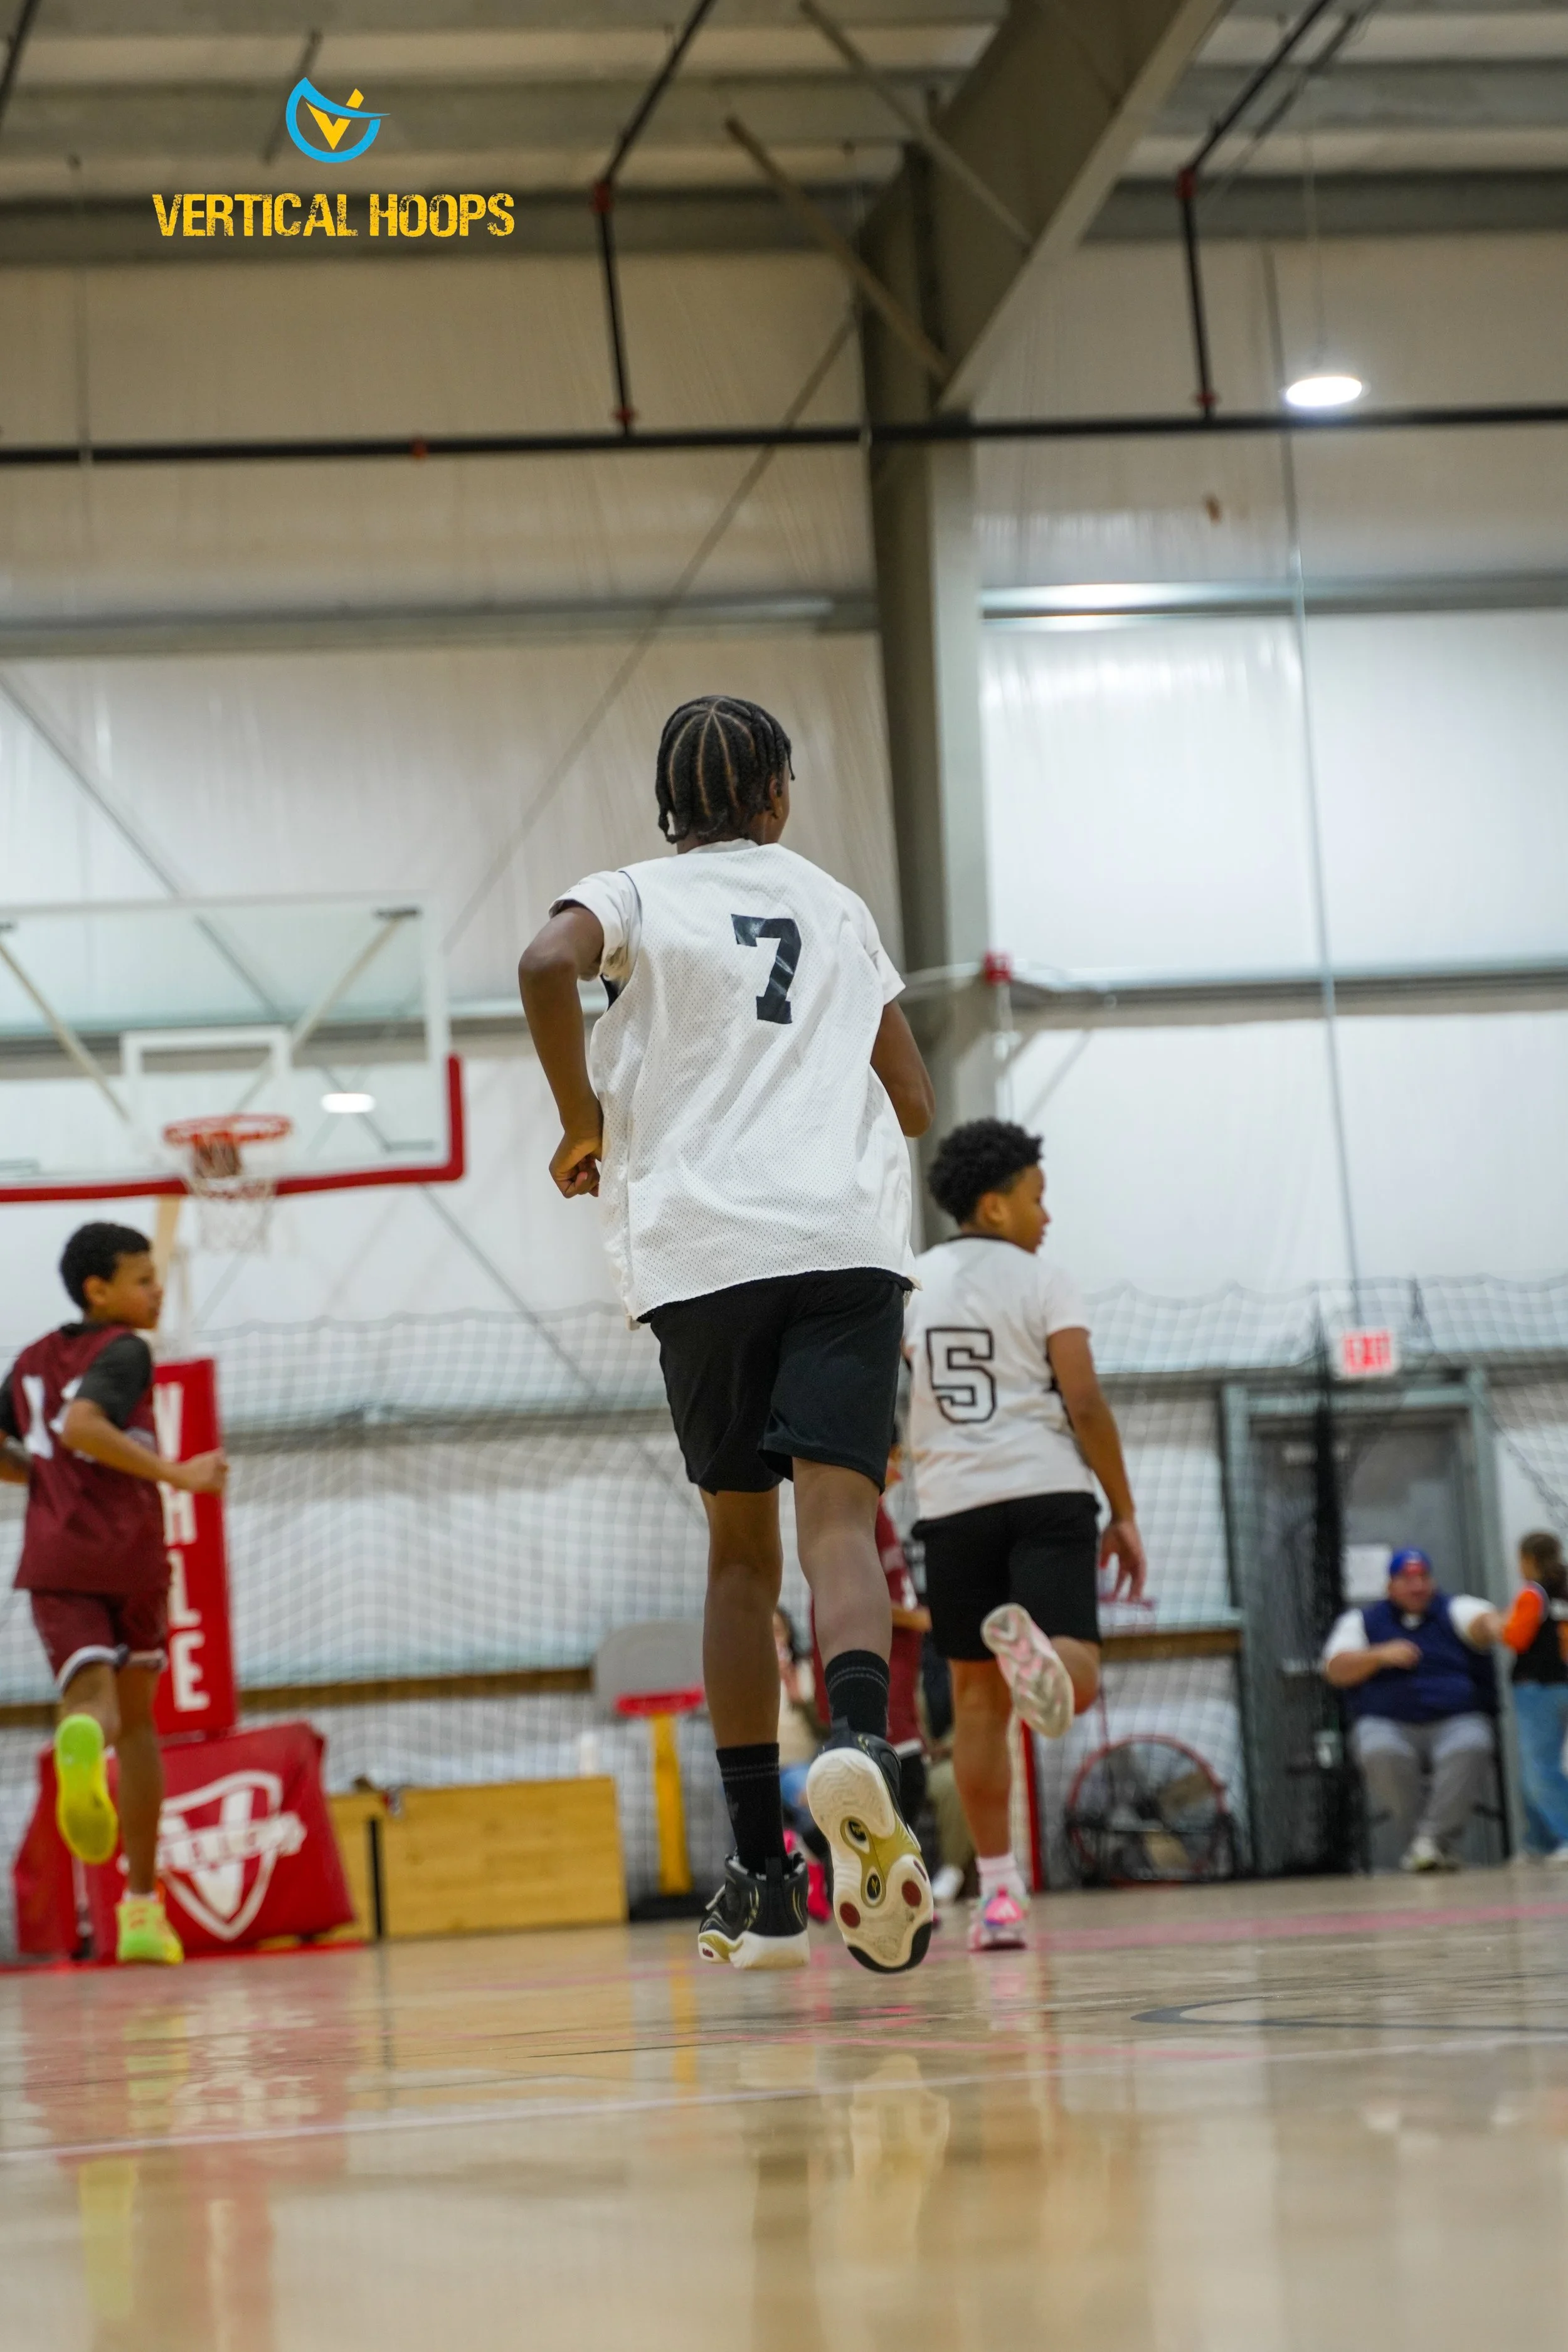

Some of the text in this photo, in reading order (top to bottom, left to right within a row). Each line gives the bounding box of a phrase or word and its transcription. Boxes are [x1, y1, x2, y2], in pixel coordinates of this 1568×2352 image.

[731, 913, 802, 1024] 7
[926, 1327, 997, 1424] 5
[1343, 1331, 1391, 1374] EXIT
